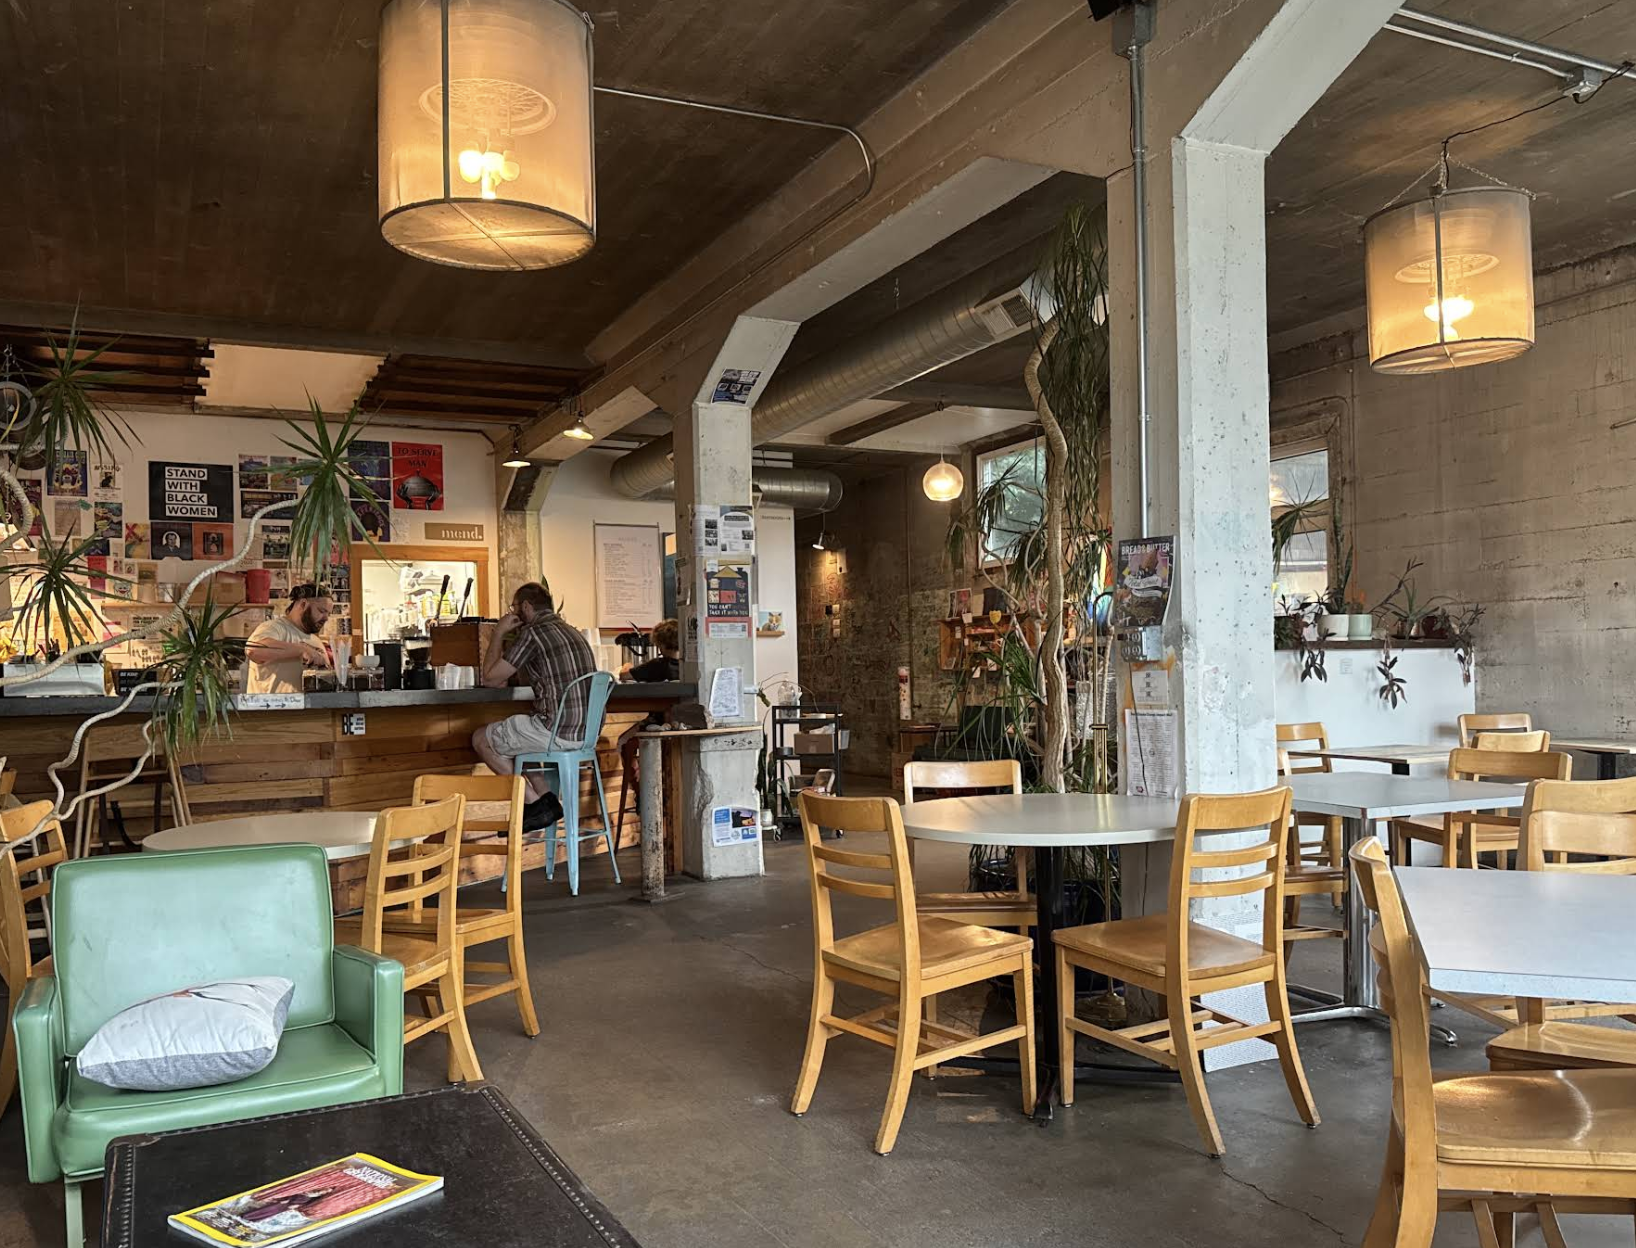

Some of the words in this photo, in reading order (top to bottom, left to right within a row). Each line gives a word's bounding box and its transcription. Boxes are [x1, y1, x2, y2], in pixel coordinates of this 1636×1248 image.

[411, 448, 437, 456] SERVE
[409, 460, 427, 468] MAN
[166, 467, 206, 479] STAND
[166, 480, 199, 492] WITH
[166, 493, 206, 504] BLACK
[167, 506, 216, 517] WOMEN
[441, 526, 483, 540] mend.
